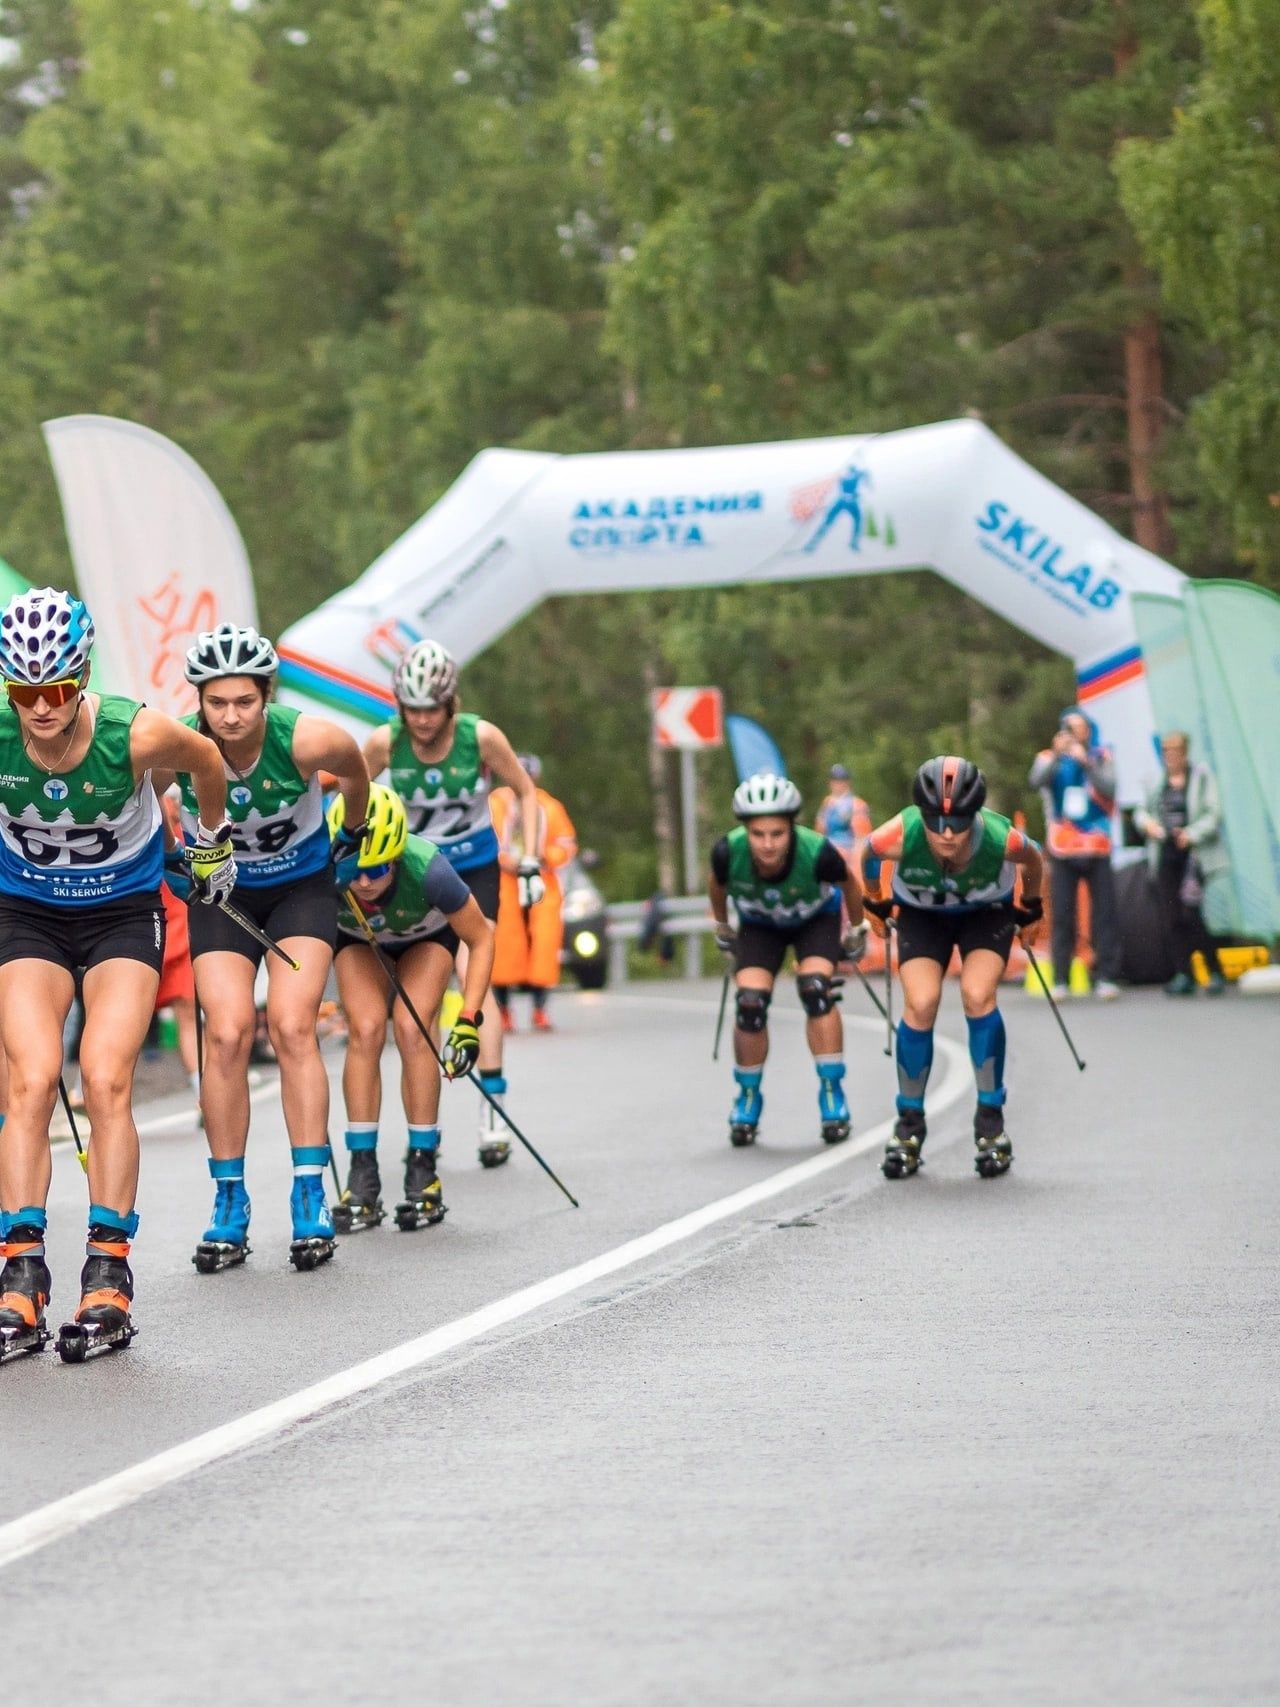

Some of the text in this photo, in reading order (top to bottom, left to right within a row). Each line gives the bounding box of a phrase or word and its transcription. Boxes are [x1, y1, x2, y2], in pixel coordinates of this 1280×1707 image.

[573, 492, 763, 520] АКАДЕМИЯ
[975, 500, 1121, 611] SKILAB
[7, 821, 119, 865] 63
[53, 885, 113, 897] SKI SERVICE
